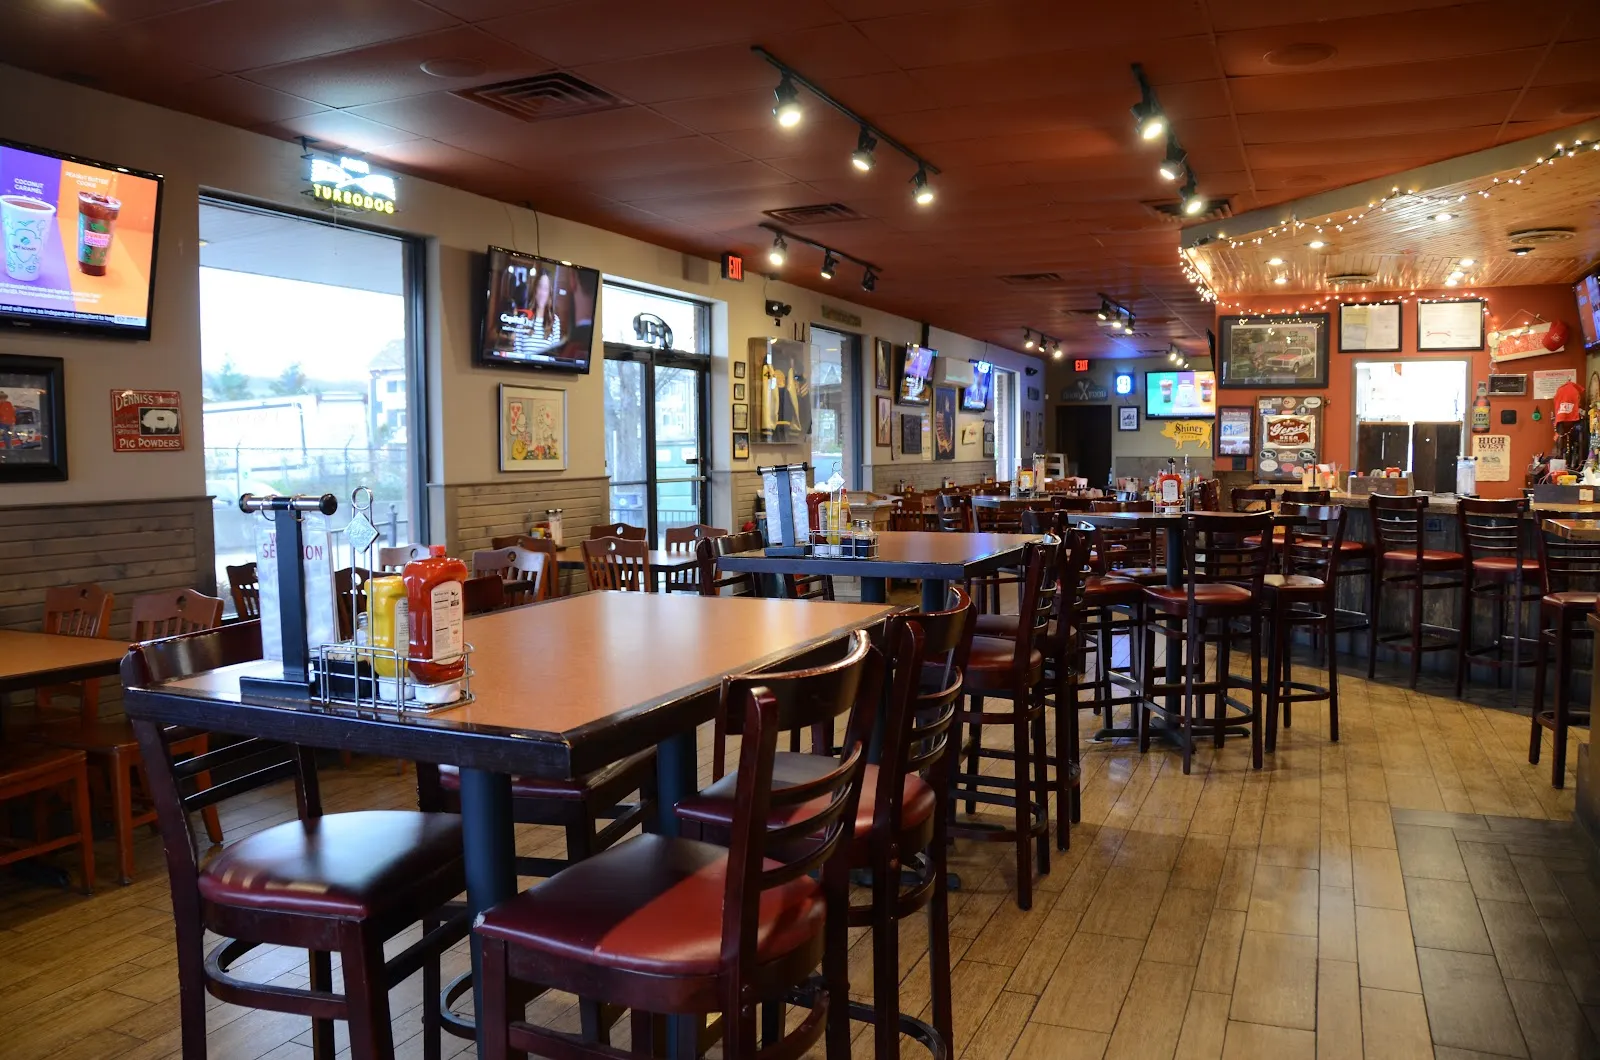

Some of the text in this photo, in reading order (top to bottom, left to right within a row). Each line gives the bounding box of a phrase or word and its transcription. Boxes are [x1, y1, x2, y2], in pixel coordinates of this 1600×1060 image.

[14, 178, 44, 189] COCONUT
[14, 184, 43, 195] CARAMEL
[313, 183, 394, 214] TURBODOG
[729, 256, 742, 280] EXIT
[1075, 359, 1088, 371] EXIT
[1174, 422, 1203, 435] Shiner
[119, 437, 180, 448] PIG POWDERS
